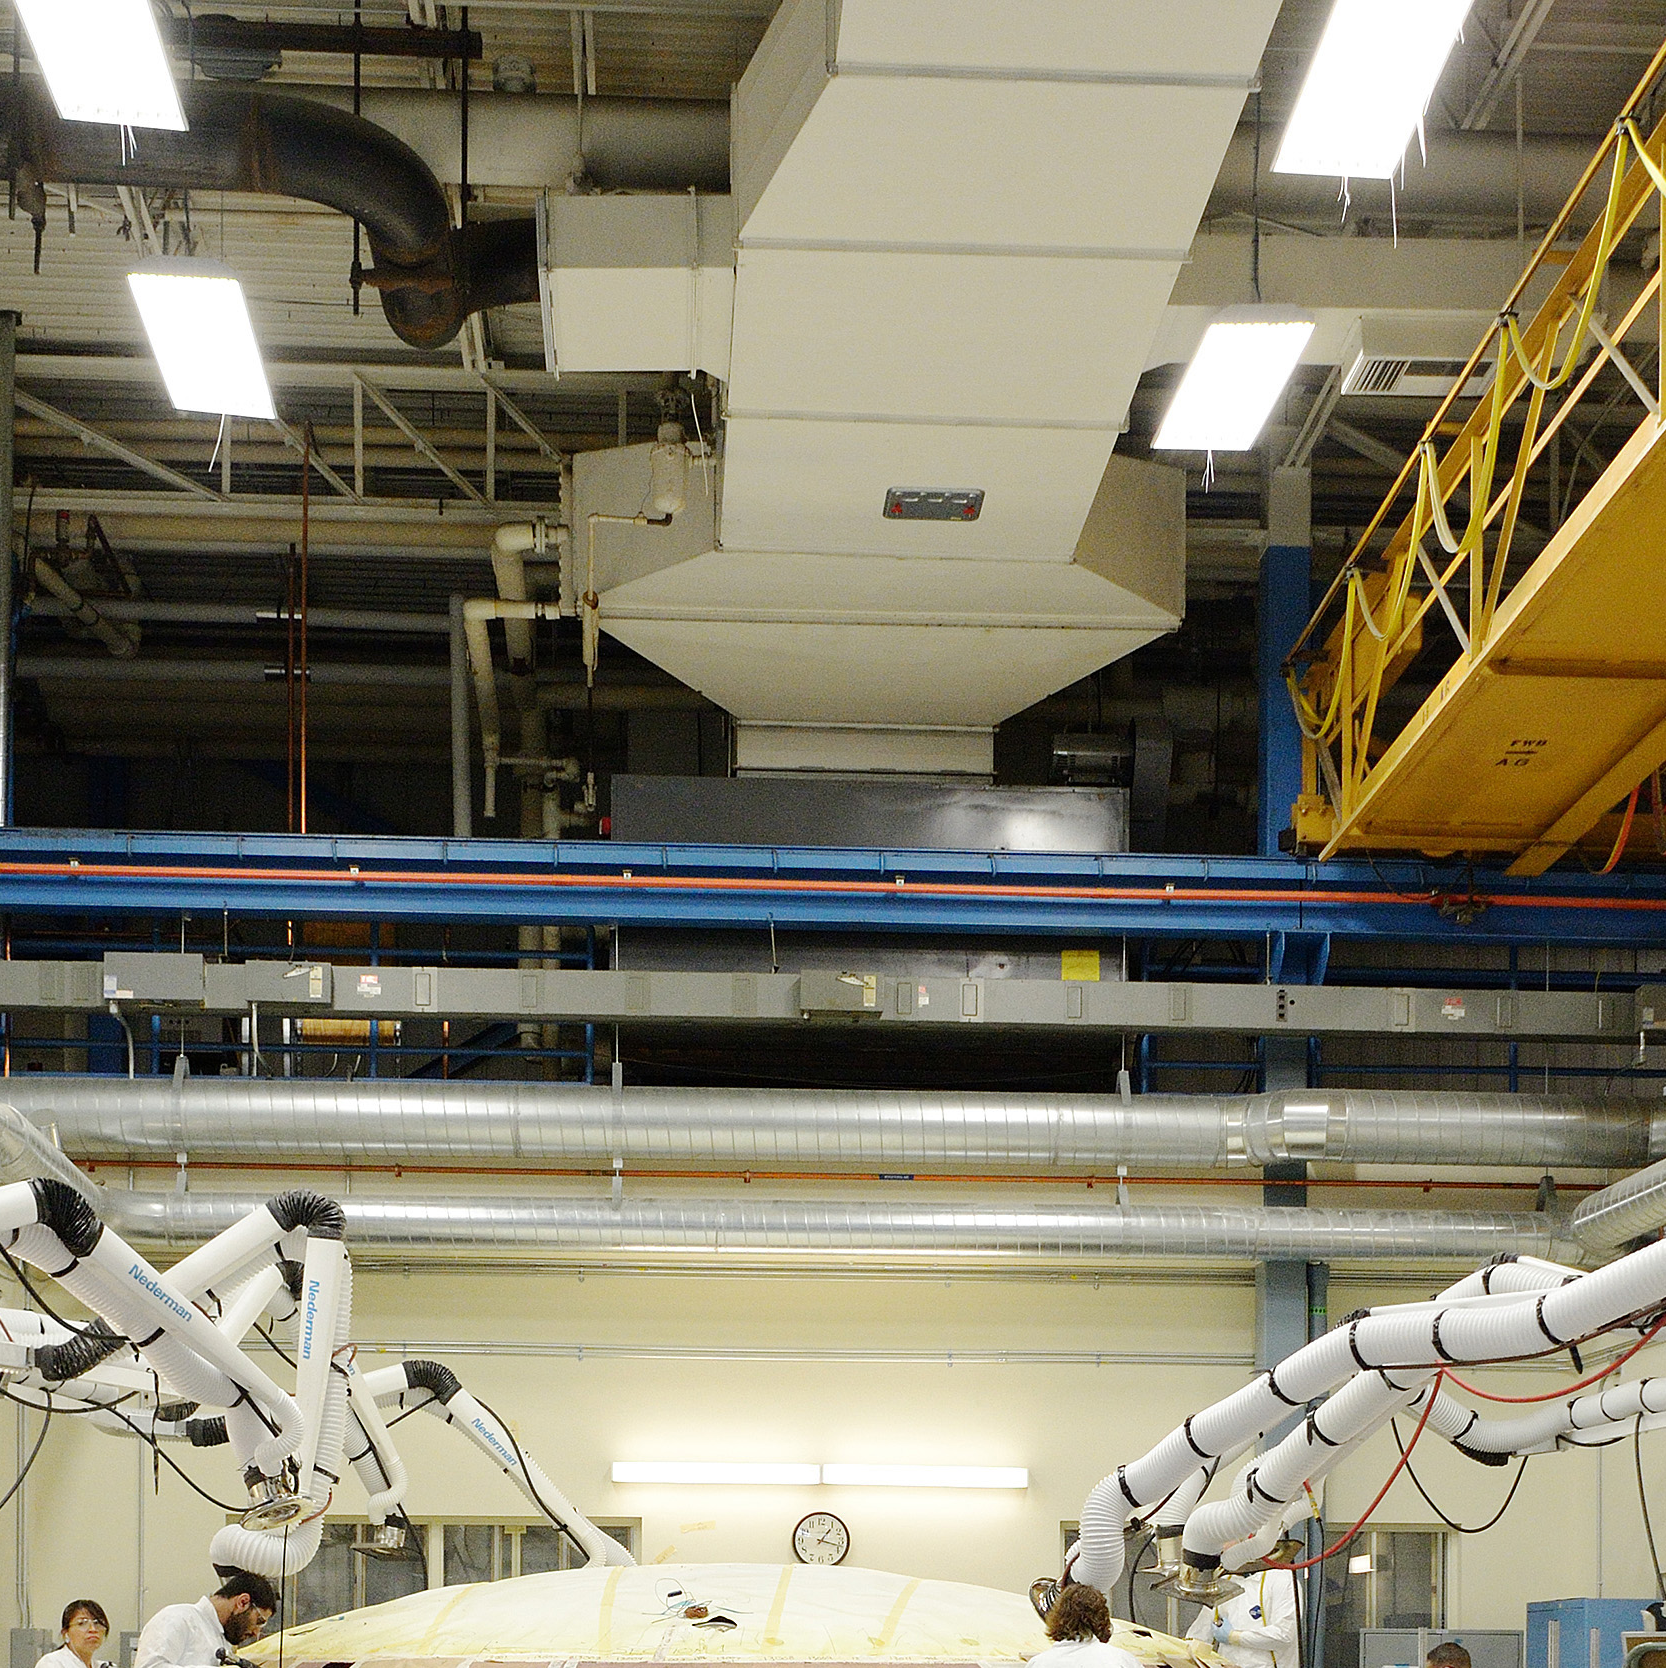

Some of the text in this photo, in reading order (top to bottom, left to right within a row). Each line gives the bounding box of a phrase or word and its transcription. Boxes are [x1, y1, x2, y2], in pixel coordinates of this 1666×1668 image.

[129, 1263, 193, 1323] Nederman
[302, 1279, 321, 1361] Nederman
[471, 1417, 518, 1466] Nederman
